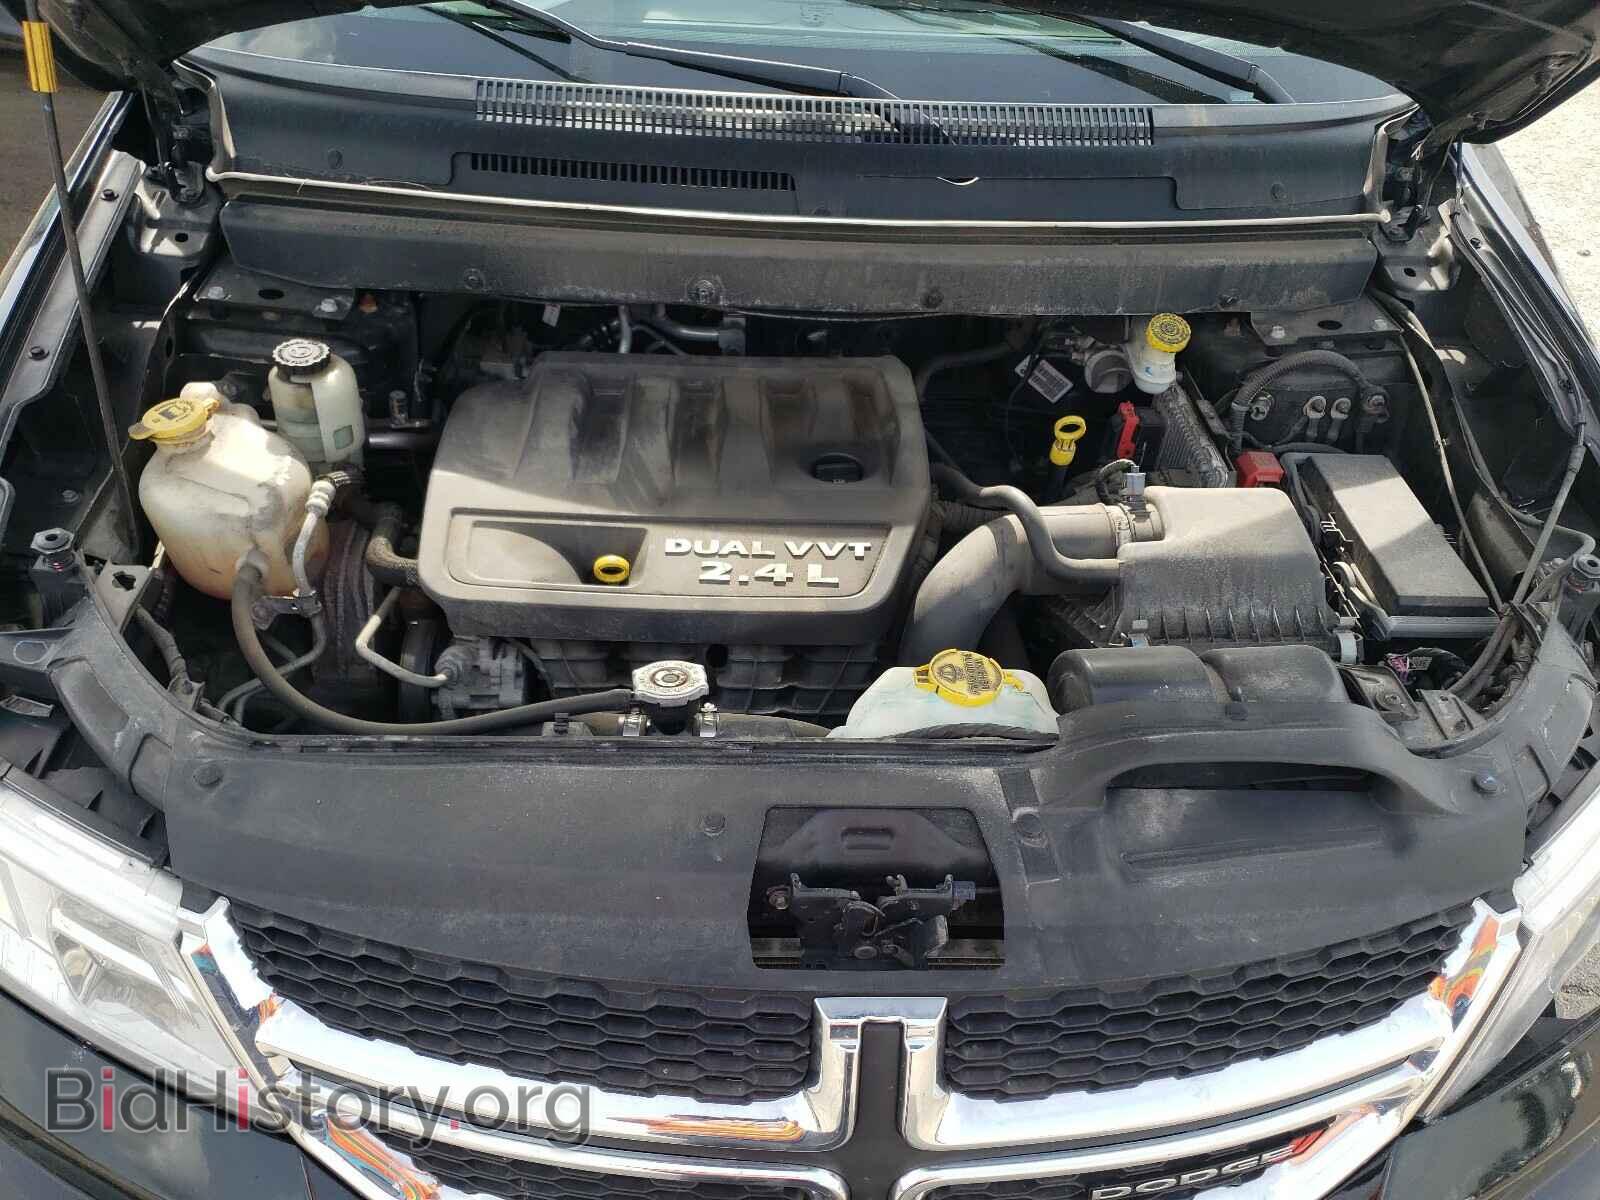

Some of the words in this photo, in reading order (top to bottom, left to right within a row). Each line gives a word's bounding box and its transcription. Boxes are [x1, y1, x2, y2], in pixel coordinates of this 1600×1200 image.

[664, 538, 776, 560] DUAL
[784, 541, 873, 561] VVT
[1091, 1143, 1295, 1200] DODGE
